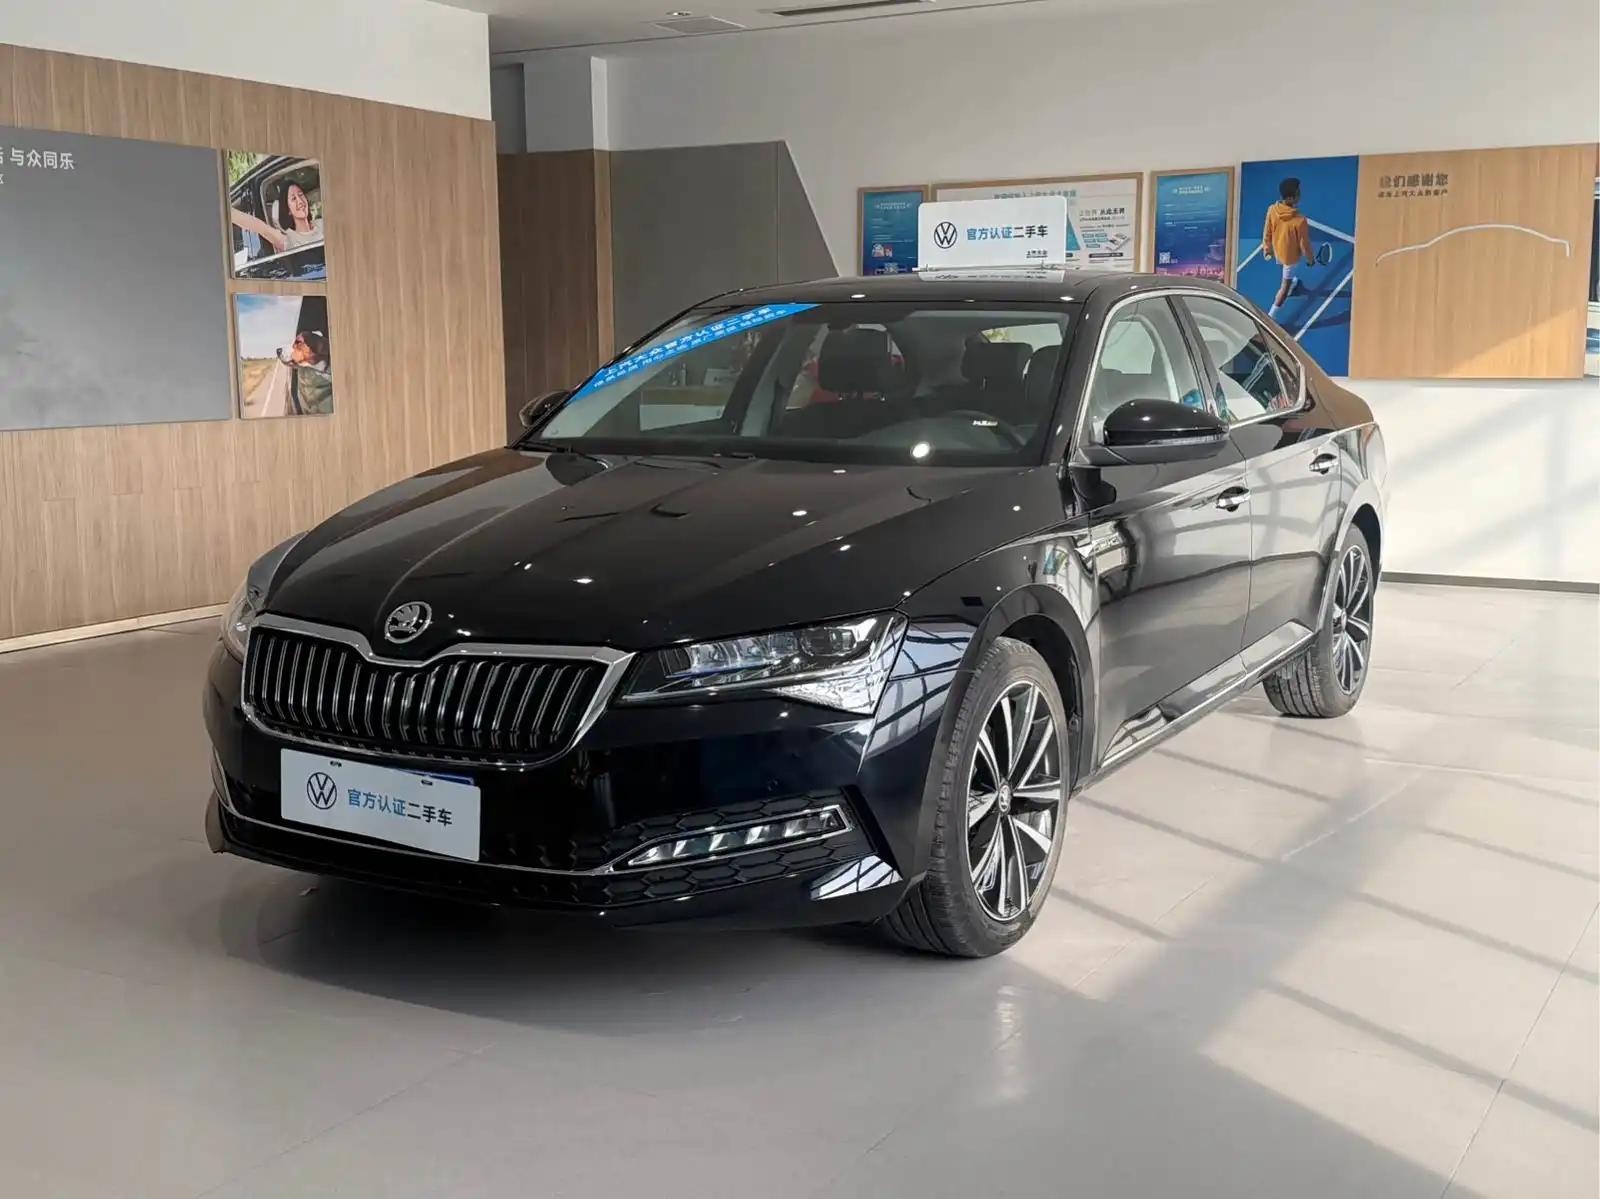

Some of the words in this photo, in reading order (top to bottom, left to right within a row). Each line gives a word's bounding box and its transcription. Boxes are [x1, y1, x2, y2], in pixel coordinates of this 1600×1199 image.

[10, 147, 75, 170] 与众同乐
[966, 225, 1048, 241] 官方认证二手车
[347, 788, 453, 826] 官方认证二手车
